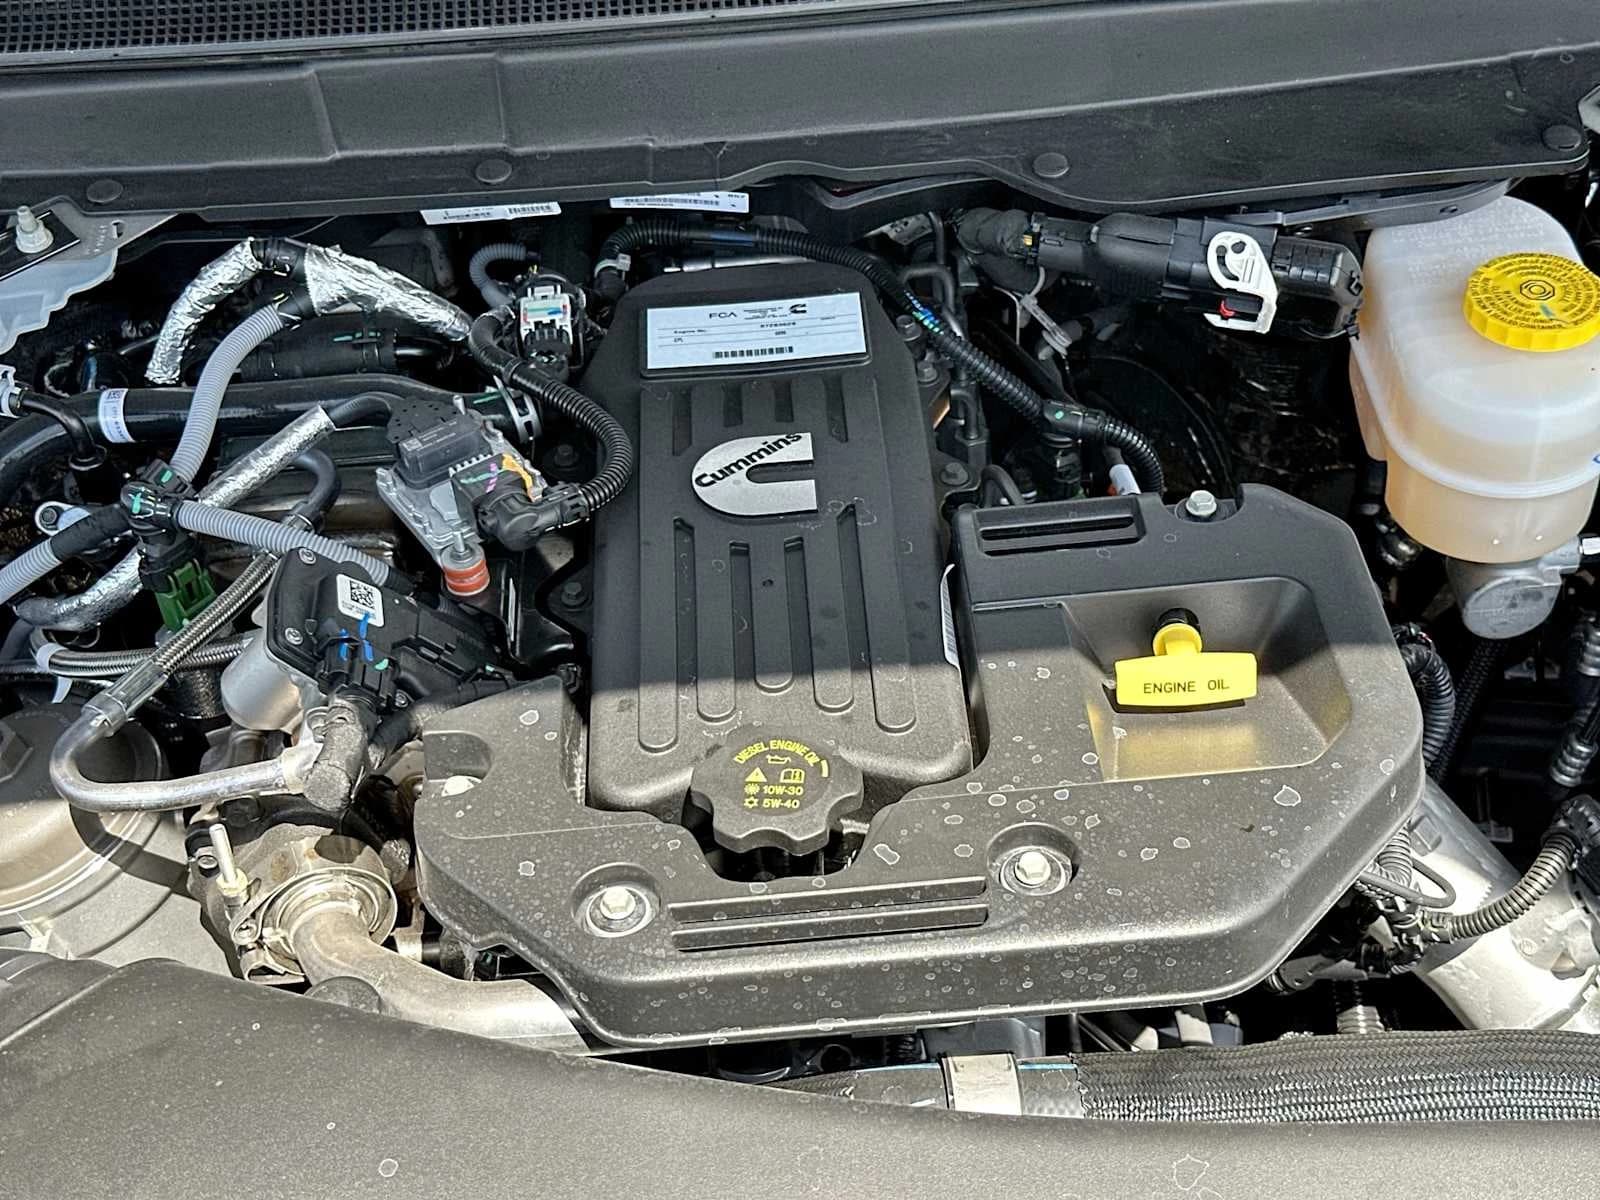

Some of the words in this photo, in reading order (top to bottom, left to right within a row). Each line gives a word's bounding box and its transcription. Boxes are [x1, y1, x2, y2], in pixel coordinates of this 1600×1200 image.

[694, 433, 803, 487] Cummins
[1143, 681, 1197, 694] ENGINE
[1207, 679, 1230, 691] OIL
[733, 741, 770, 764] DIESEL
[769, 739, 810, 757] ENGINE
[803, 751, 820, 767] OIL
[762, 785, 804, 796] 10W-30
[762, 798, 800, 809] 5W-40
